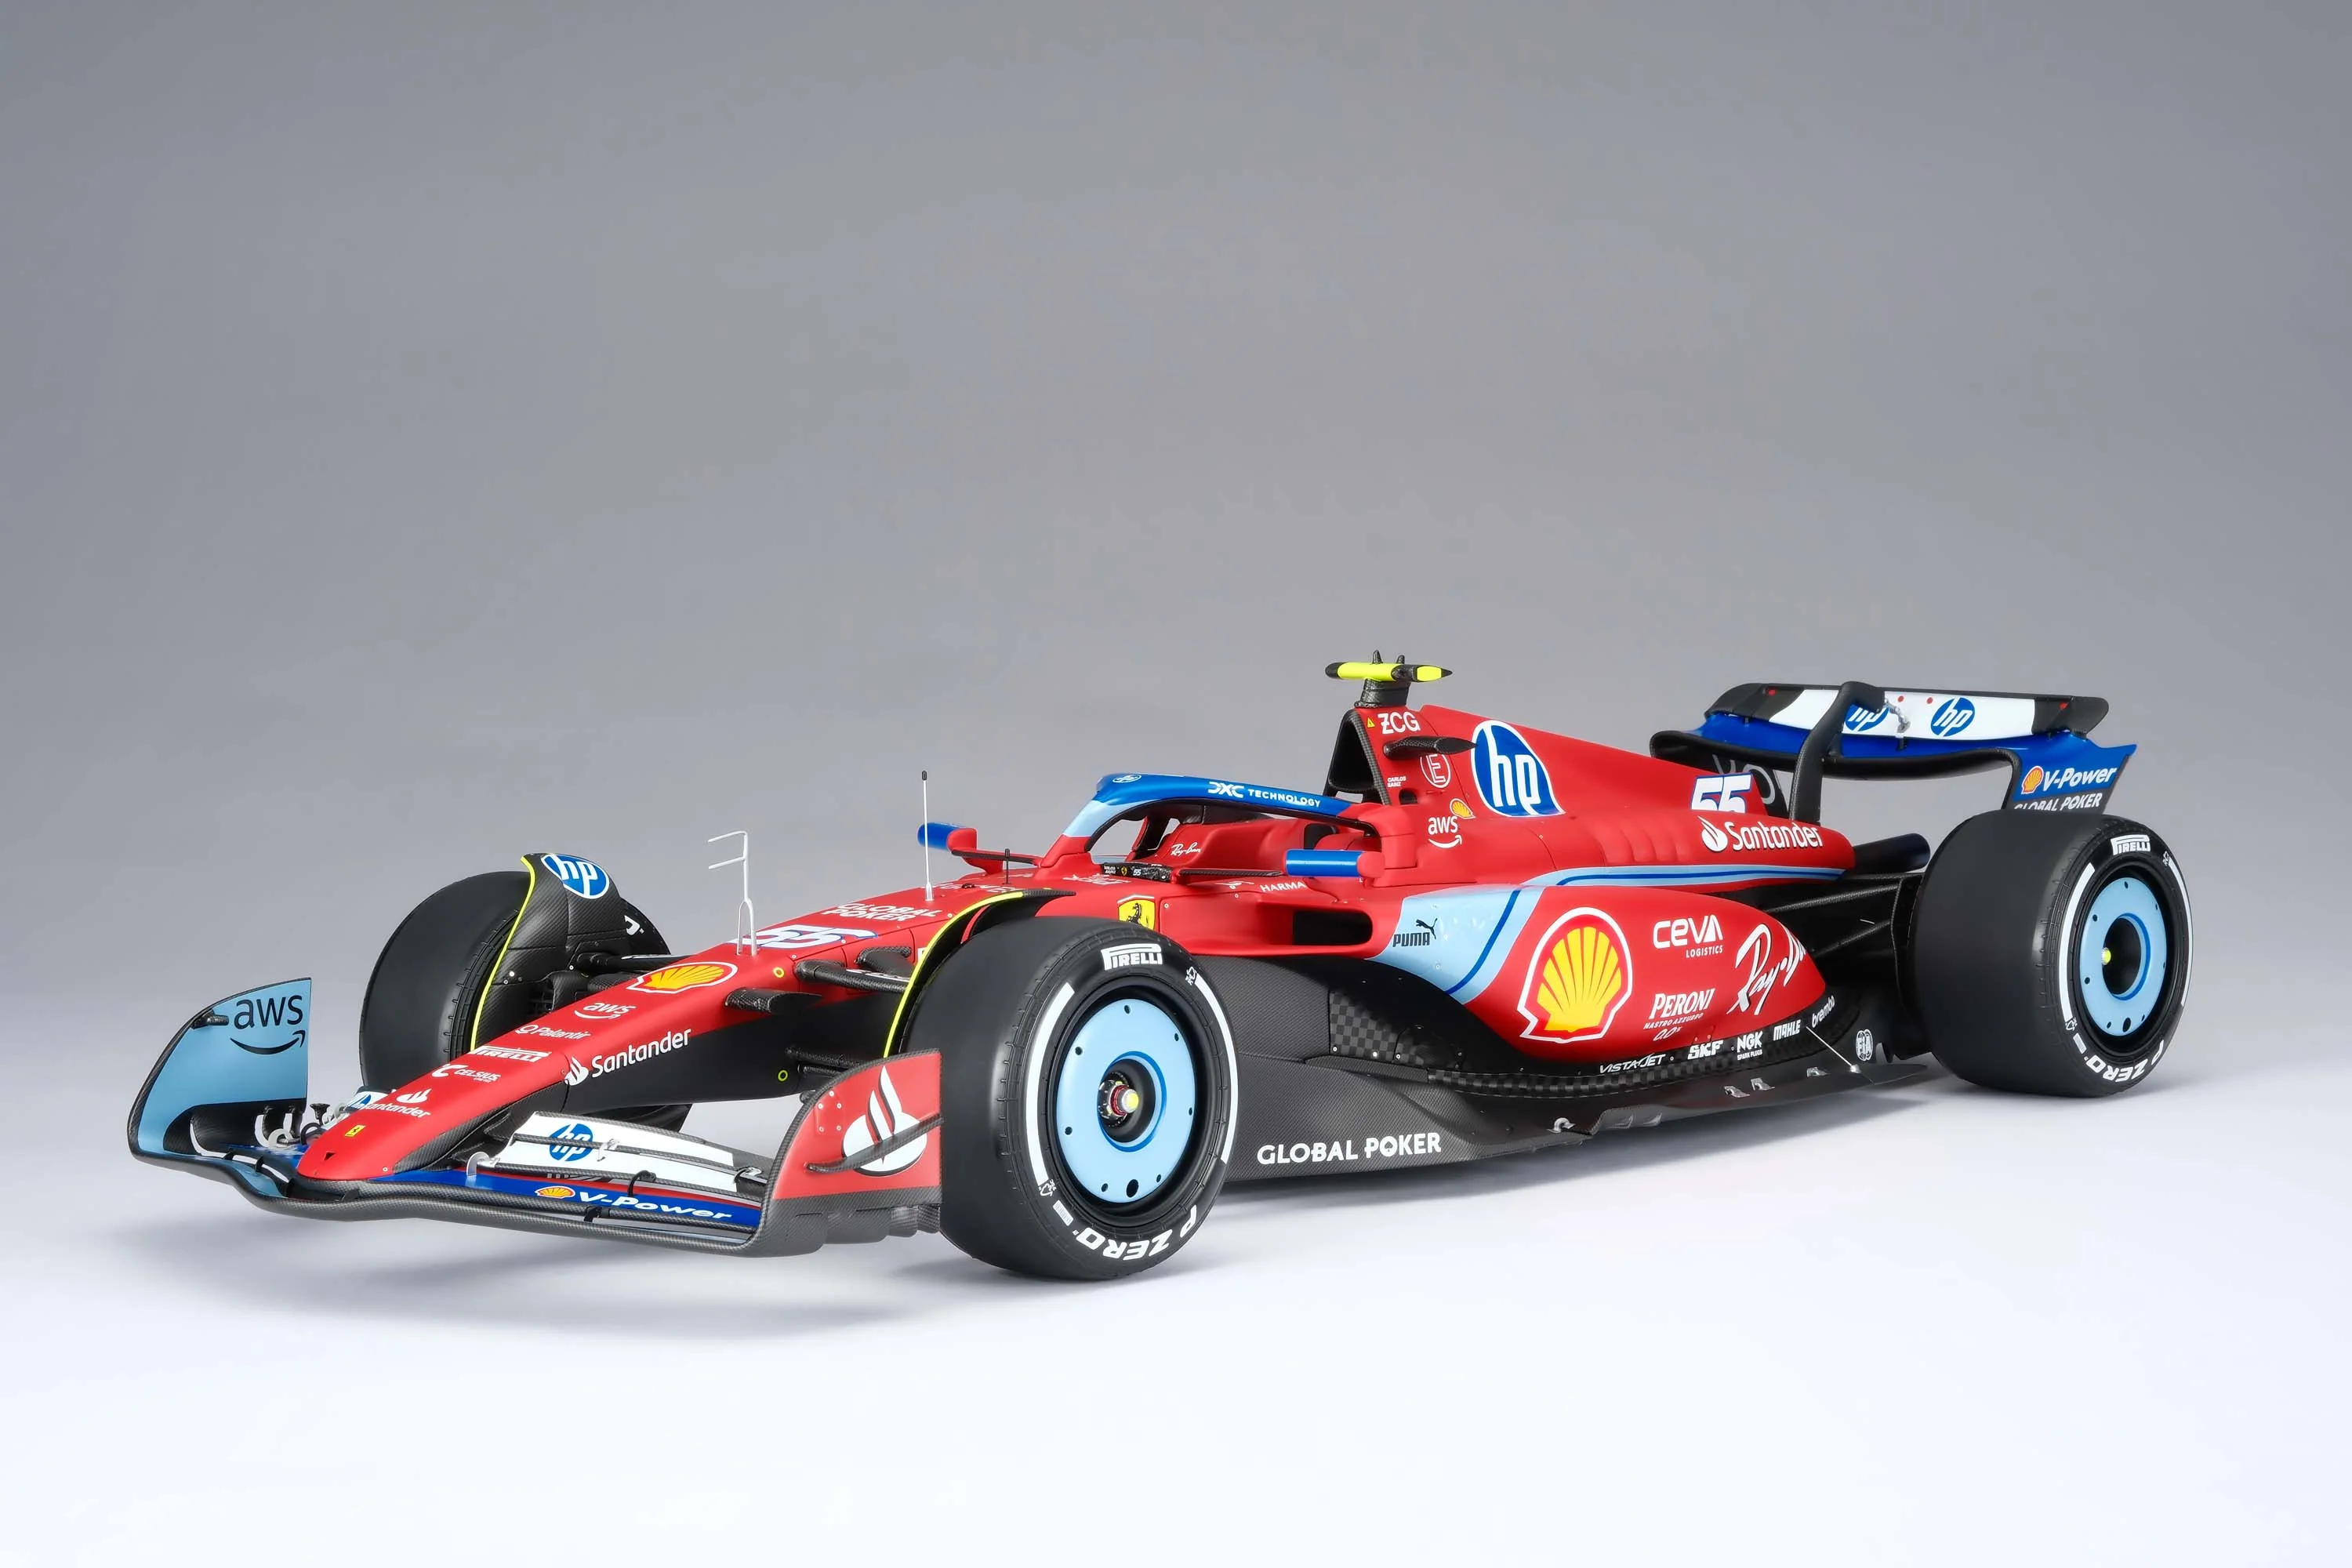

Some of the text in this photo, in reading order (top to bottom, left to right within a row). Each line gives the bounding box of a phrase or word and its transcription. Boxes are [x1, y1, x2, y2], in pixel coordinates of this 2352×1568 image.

[1935, 698, 1973, 736] hp
[1482, 720, 1543, 817] hp
[2043, 768, 2118, 792] V-Power
[1247, 789, 1321, 808] TECHNOLOGY
[1691, 772, 1751, 814] 55
[2060, 793, 2103, 811] POKER
[1428, 815, 1458, 836] aws
[1725, 822, 1824, 851] Santander
[2111, 834, 2151, 855] PIRELLI
[550, 854, 601, 898] hp
[838, 903, 943, 917] GLOBAL
[1392, 932, 1431, 947] PUMA
[1686, 945, 1723, 959] LOGISTICS
[1101, 943, 1163, 970] PIRELLI
[234, 994, 303, 1029] aws
[583, 1002, 637, 1014] aws
[1649, 988, 1715, 1019] PERONI
[1811, 994, 1835, 1029] brembo
[530, 1026, 591, 1040] Palantir
[1737, 1030, 1763, 1053] NGK
[1773, 1019, 1802, 1041] MAHLE
[473, 1046, 551, 1063] PIRELLI
[591, 1028, 691, 1078] Santander
[1687, 1040, 1724, 1060] SKF
[2085, 1054, 2148, 1082] ZERO
[1257, 1132, 1442, 1164] GLOBAL POKER
[579, 1191, 732, 1220] V-Power
[1076, 1227, 1173, 1261] ZERO
